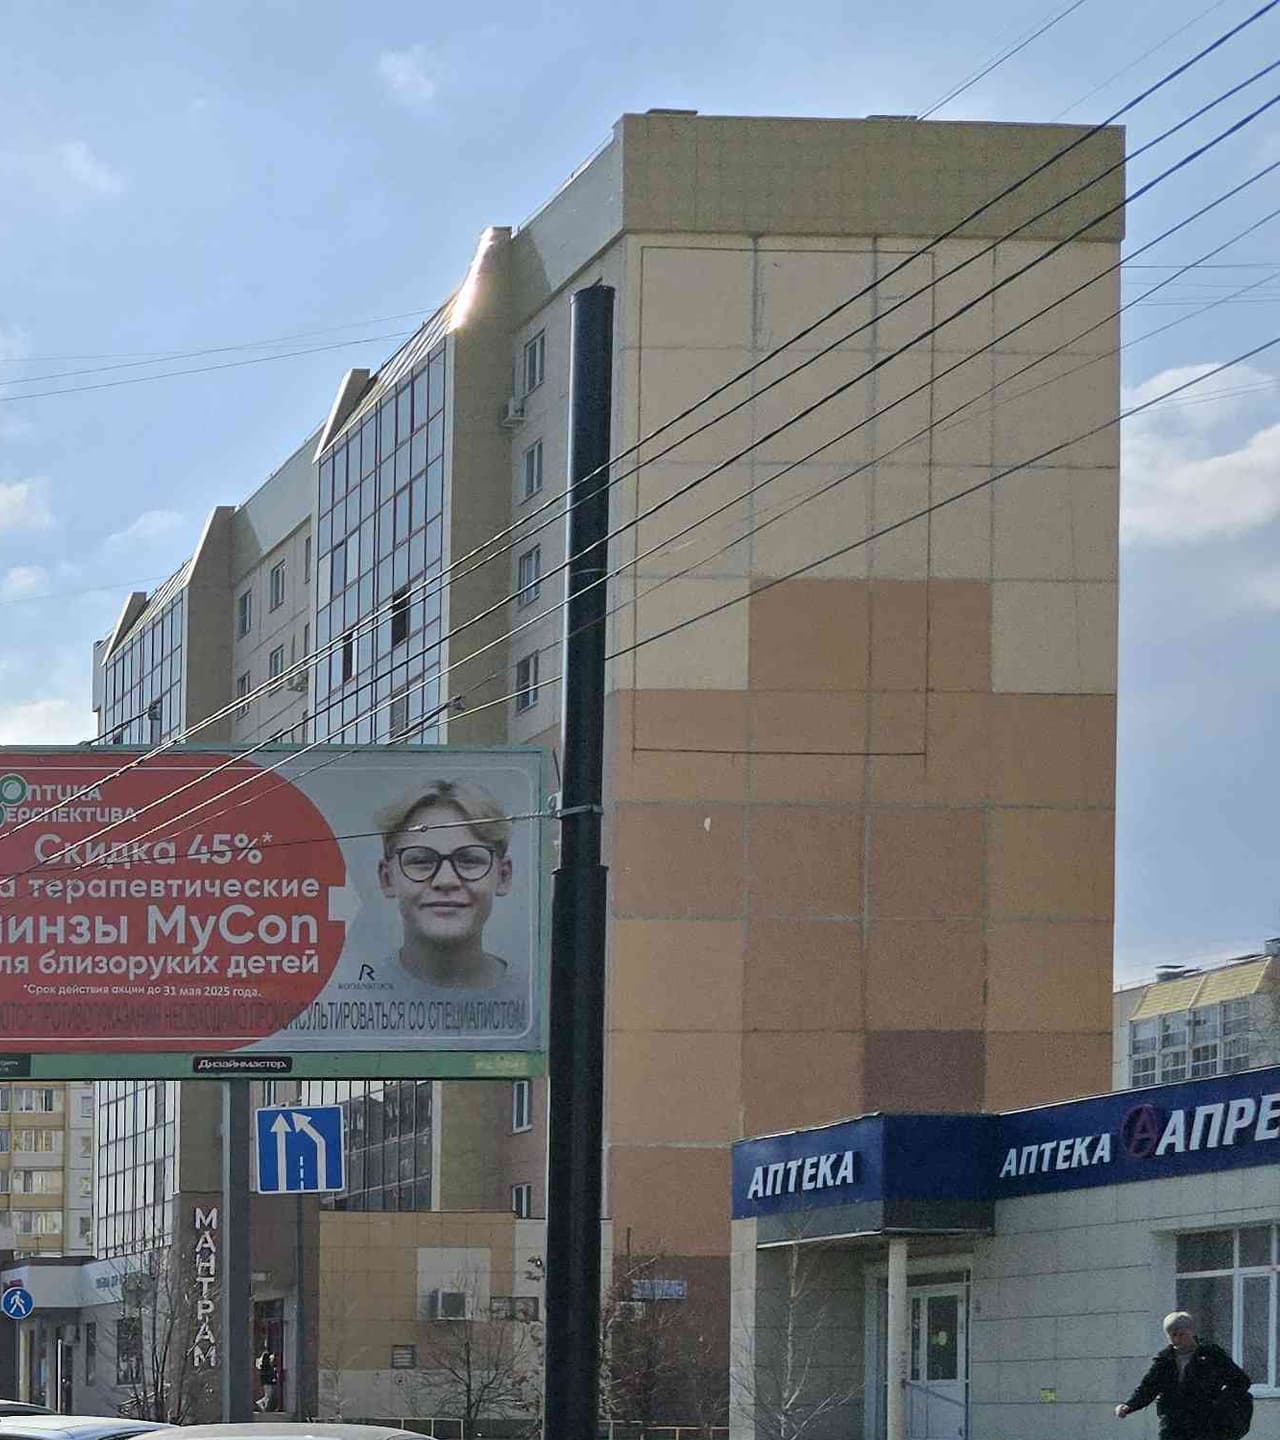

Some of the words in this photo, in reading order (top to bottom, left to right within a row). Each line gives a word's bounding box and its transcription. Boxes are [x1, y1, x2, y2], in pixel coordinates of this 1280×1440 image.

[34, 833, 176, 869] Скидка
[28, 878, 320, 904] терапевтические
[147, 903, 317, 953] MyCon
[39, 950, 218, 980] близоруких
[227, 950, 319, 978] детей
[58, 984, 109, 995] действия
[111, 985, 145, 995] акции
[147, 985, 160, 995] до
[162, 986, 176, 996] 31
[180, 987, 201, 996] мая
[203, 986, 230, 996] 2025
[408, 1001, 425, 1029] СО
[428, 1001, 524, 1032] СПЕЦИАЛИСТОМ
[999, 1133, 1111, 1178] АПТЕКА
[747, 1150, 855, 1199] АПТЕКА
[194, 1207, 218, 1367] МАНТРАМ
